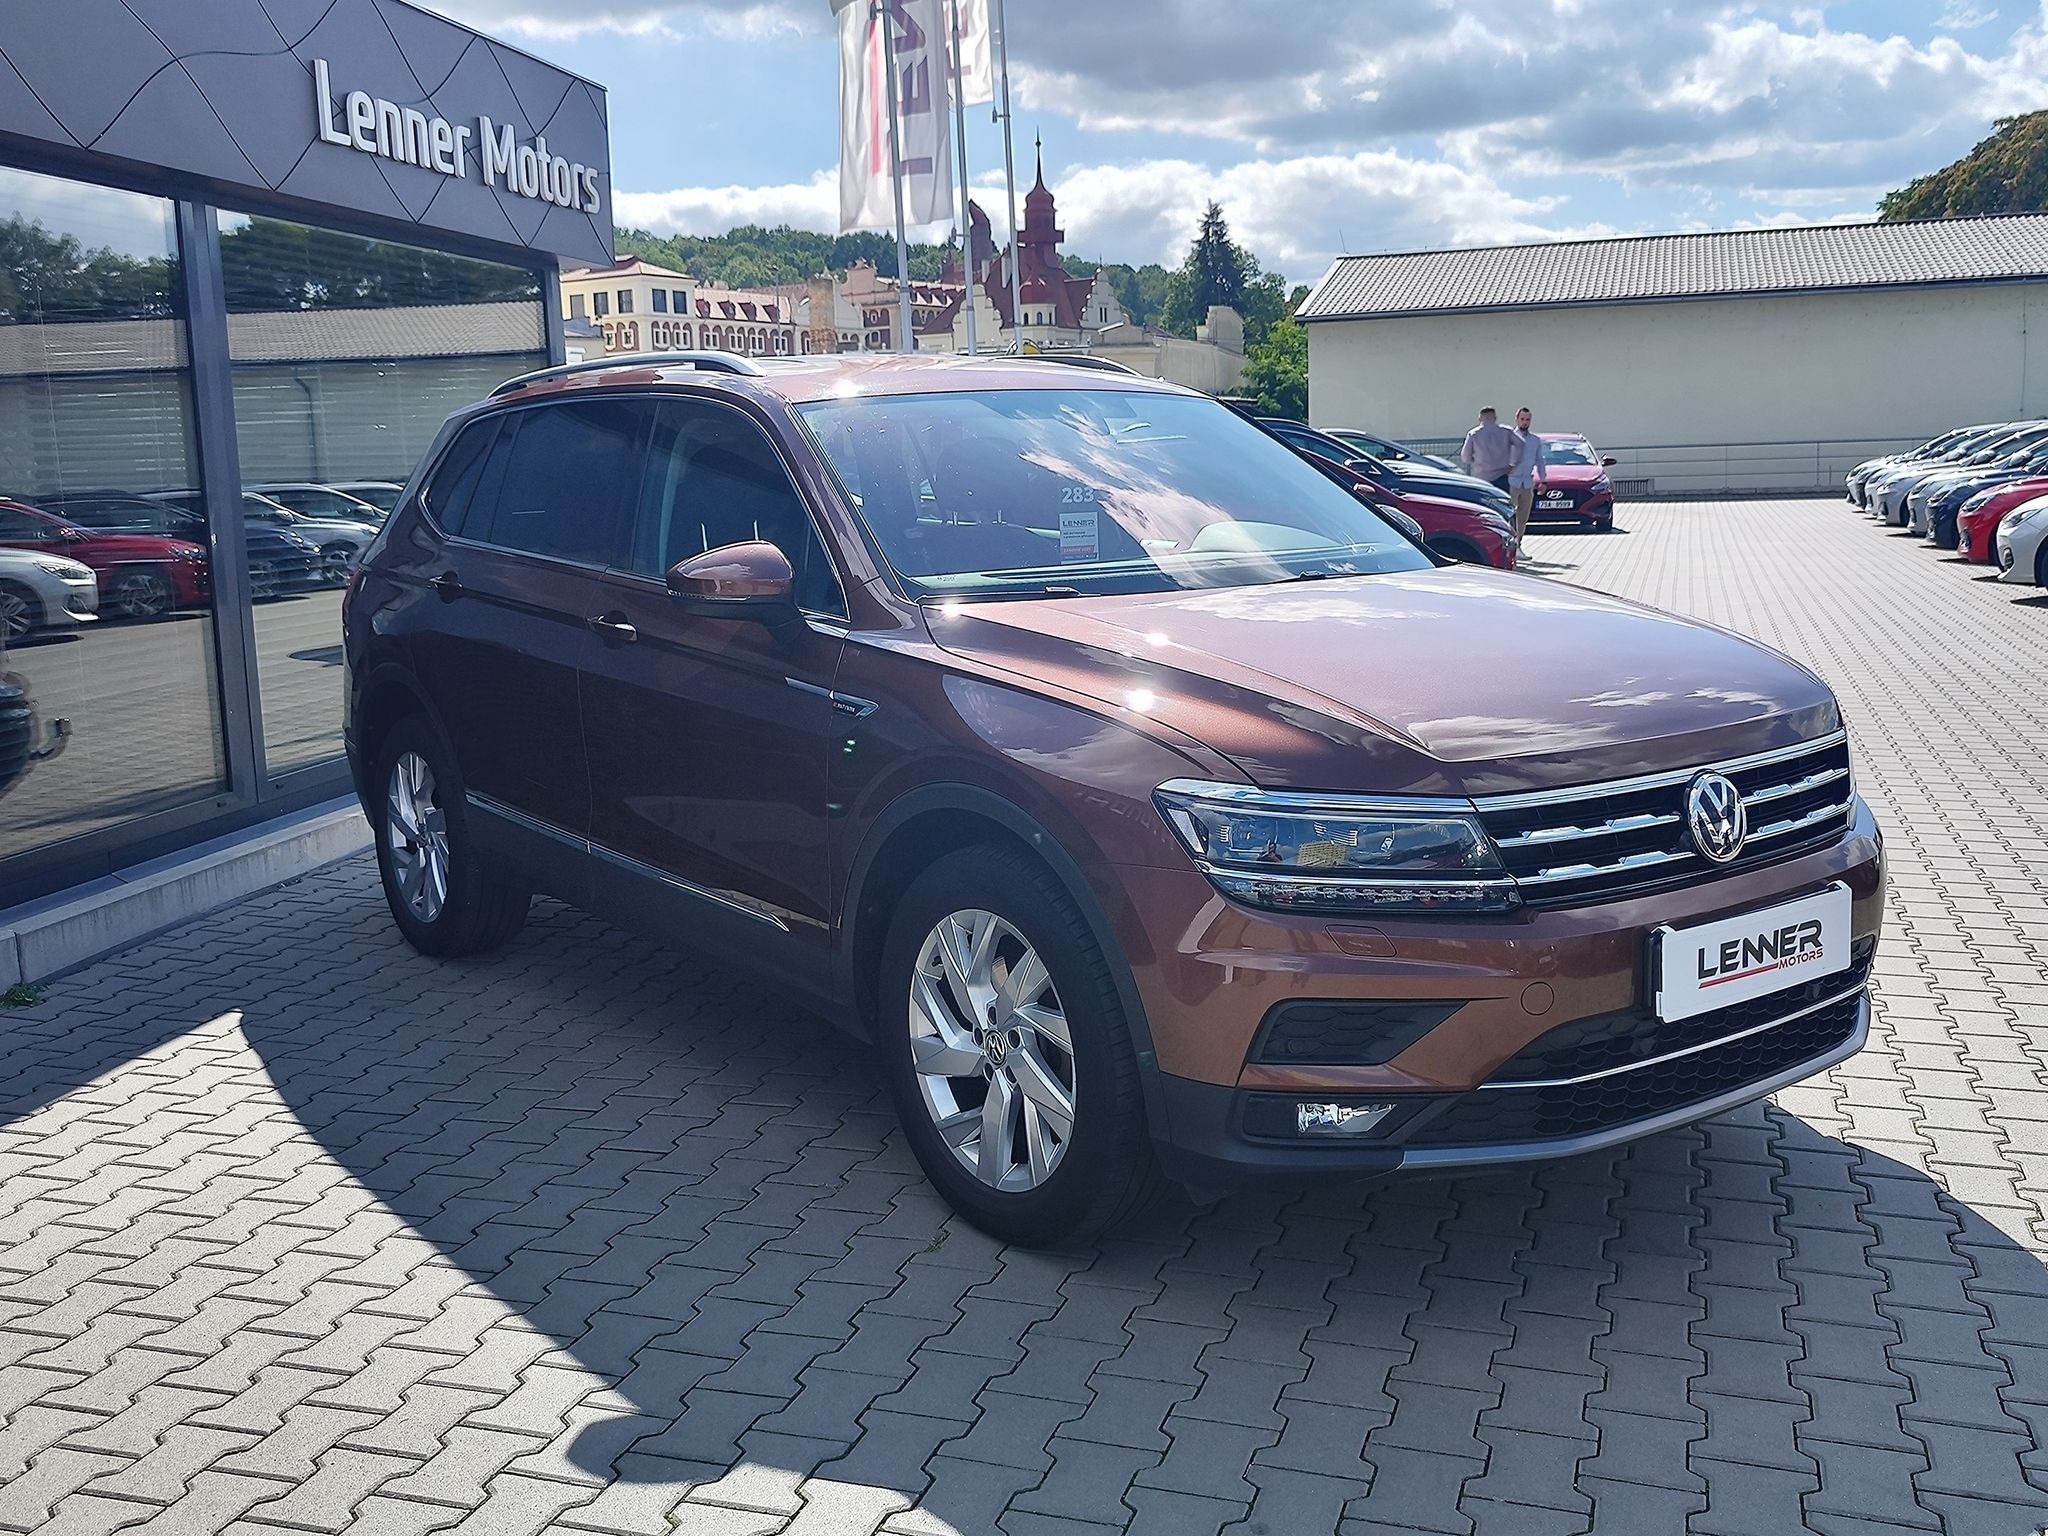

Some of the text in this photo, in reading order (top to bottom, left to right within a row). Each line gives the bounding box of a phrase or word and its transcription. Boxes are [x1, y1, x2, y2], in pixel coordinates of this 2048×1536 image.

[313, 58, 600, 214] Lenner Motors
[1061, 487, 1095, 503] 283
[1062, 519, 1096, 528] LENNER
[1697, 919, 1824, 980] LENNER
[1778, 949, 1824, 970] MOTORS
